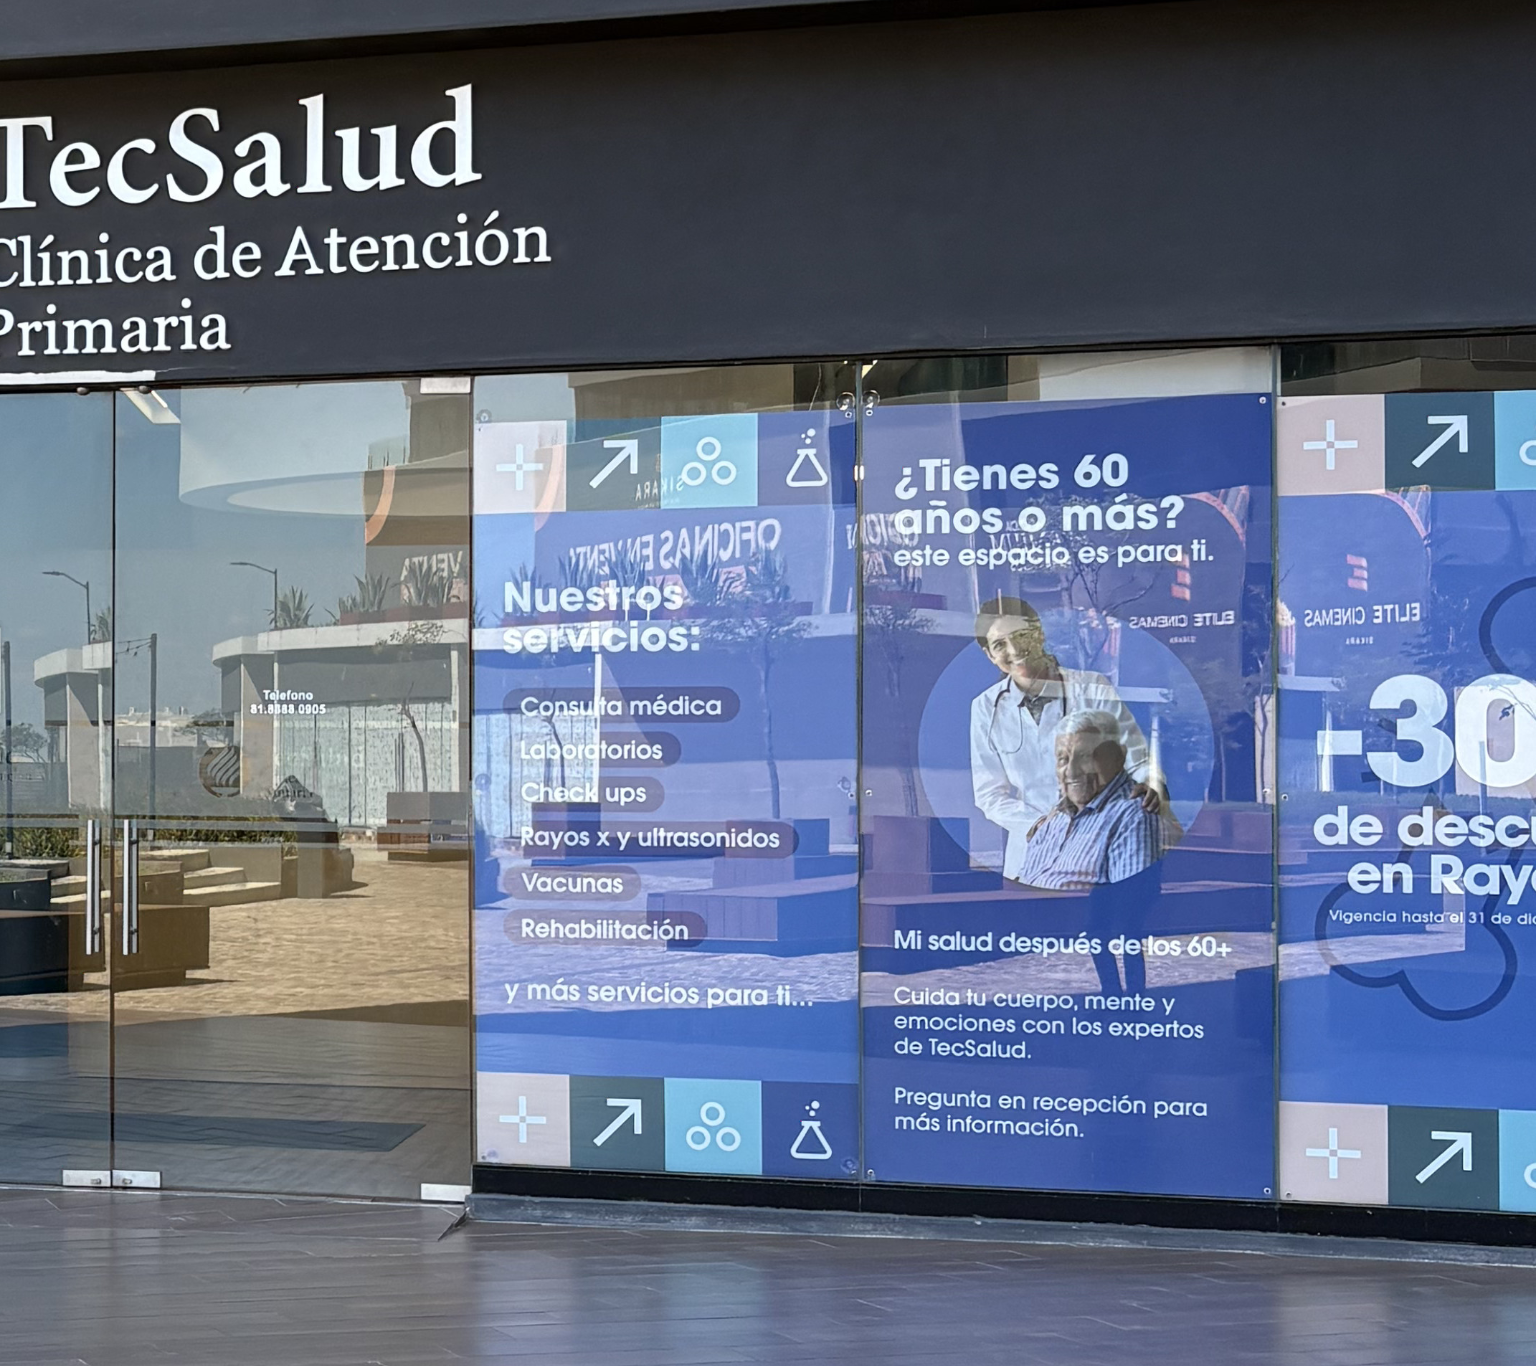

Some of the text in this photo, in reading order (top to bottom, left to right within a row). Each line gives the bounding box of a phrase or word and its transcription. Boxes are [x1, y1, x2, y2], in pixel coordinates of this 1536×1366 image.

[193, 225, 263, 281] de
[275, 210, 552, 279] Atención
[894, 453, 1129, 500] ¿Tienes 60
[894, 500, 1004, 535] años
[1018, 506, 1047, 532] o
[1063, 492, 1186, 533] más?
[893, 538, 1215, 571] este espacio es para ti.
[503, 581, 684, 614] Nuestros
[503, 620, 701, 654] servicios:
[520, 694, 722, 716] Consulta médica
[520, 739, 663, 760] Laboratorios
[521, 782, 647, 805] Check ups
[520, 826, 781, 851] Rayos x y ultrasonidos
[1313, 805, 1536, 848] de desc
[521, 872, 624, 894] Vacunas
[1347, 853, 1536, 906] en Ray
[521, 917, 689, 941] Rehabilitación
[1329, 909, 1397, 925] Vigencia
[1402, 909, 1445, 924] hasta
[1449, 910, 1464, 923] el
[1468, 912, 1484, 924] 31
[1490, 911, 1511, 925] de
[893, 929, 1232, 958] Mi salud después de los 60+
[504, 978, 814, 1009] y más servicios para ti...
[894, 986, 1176, 1015] Cuida tu cuerpo, mente y
[894, 1013, 1205, 1040] emociones con los expertos
[894, 1037, 1032, 1059] de TecSalud.
[894, 1087, 1208, 1119] Pregunta en recepción para
[894, 1113, 1084, 1138] más información.
